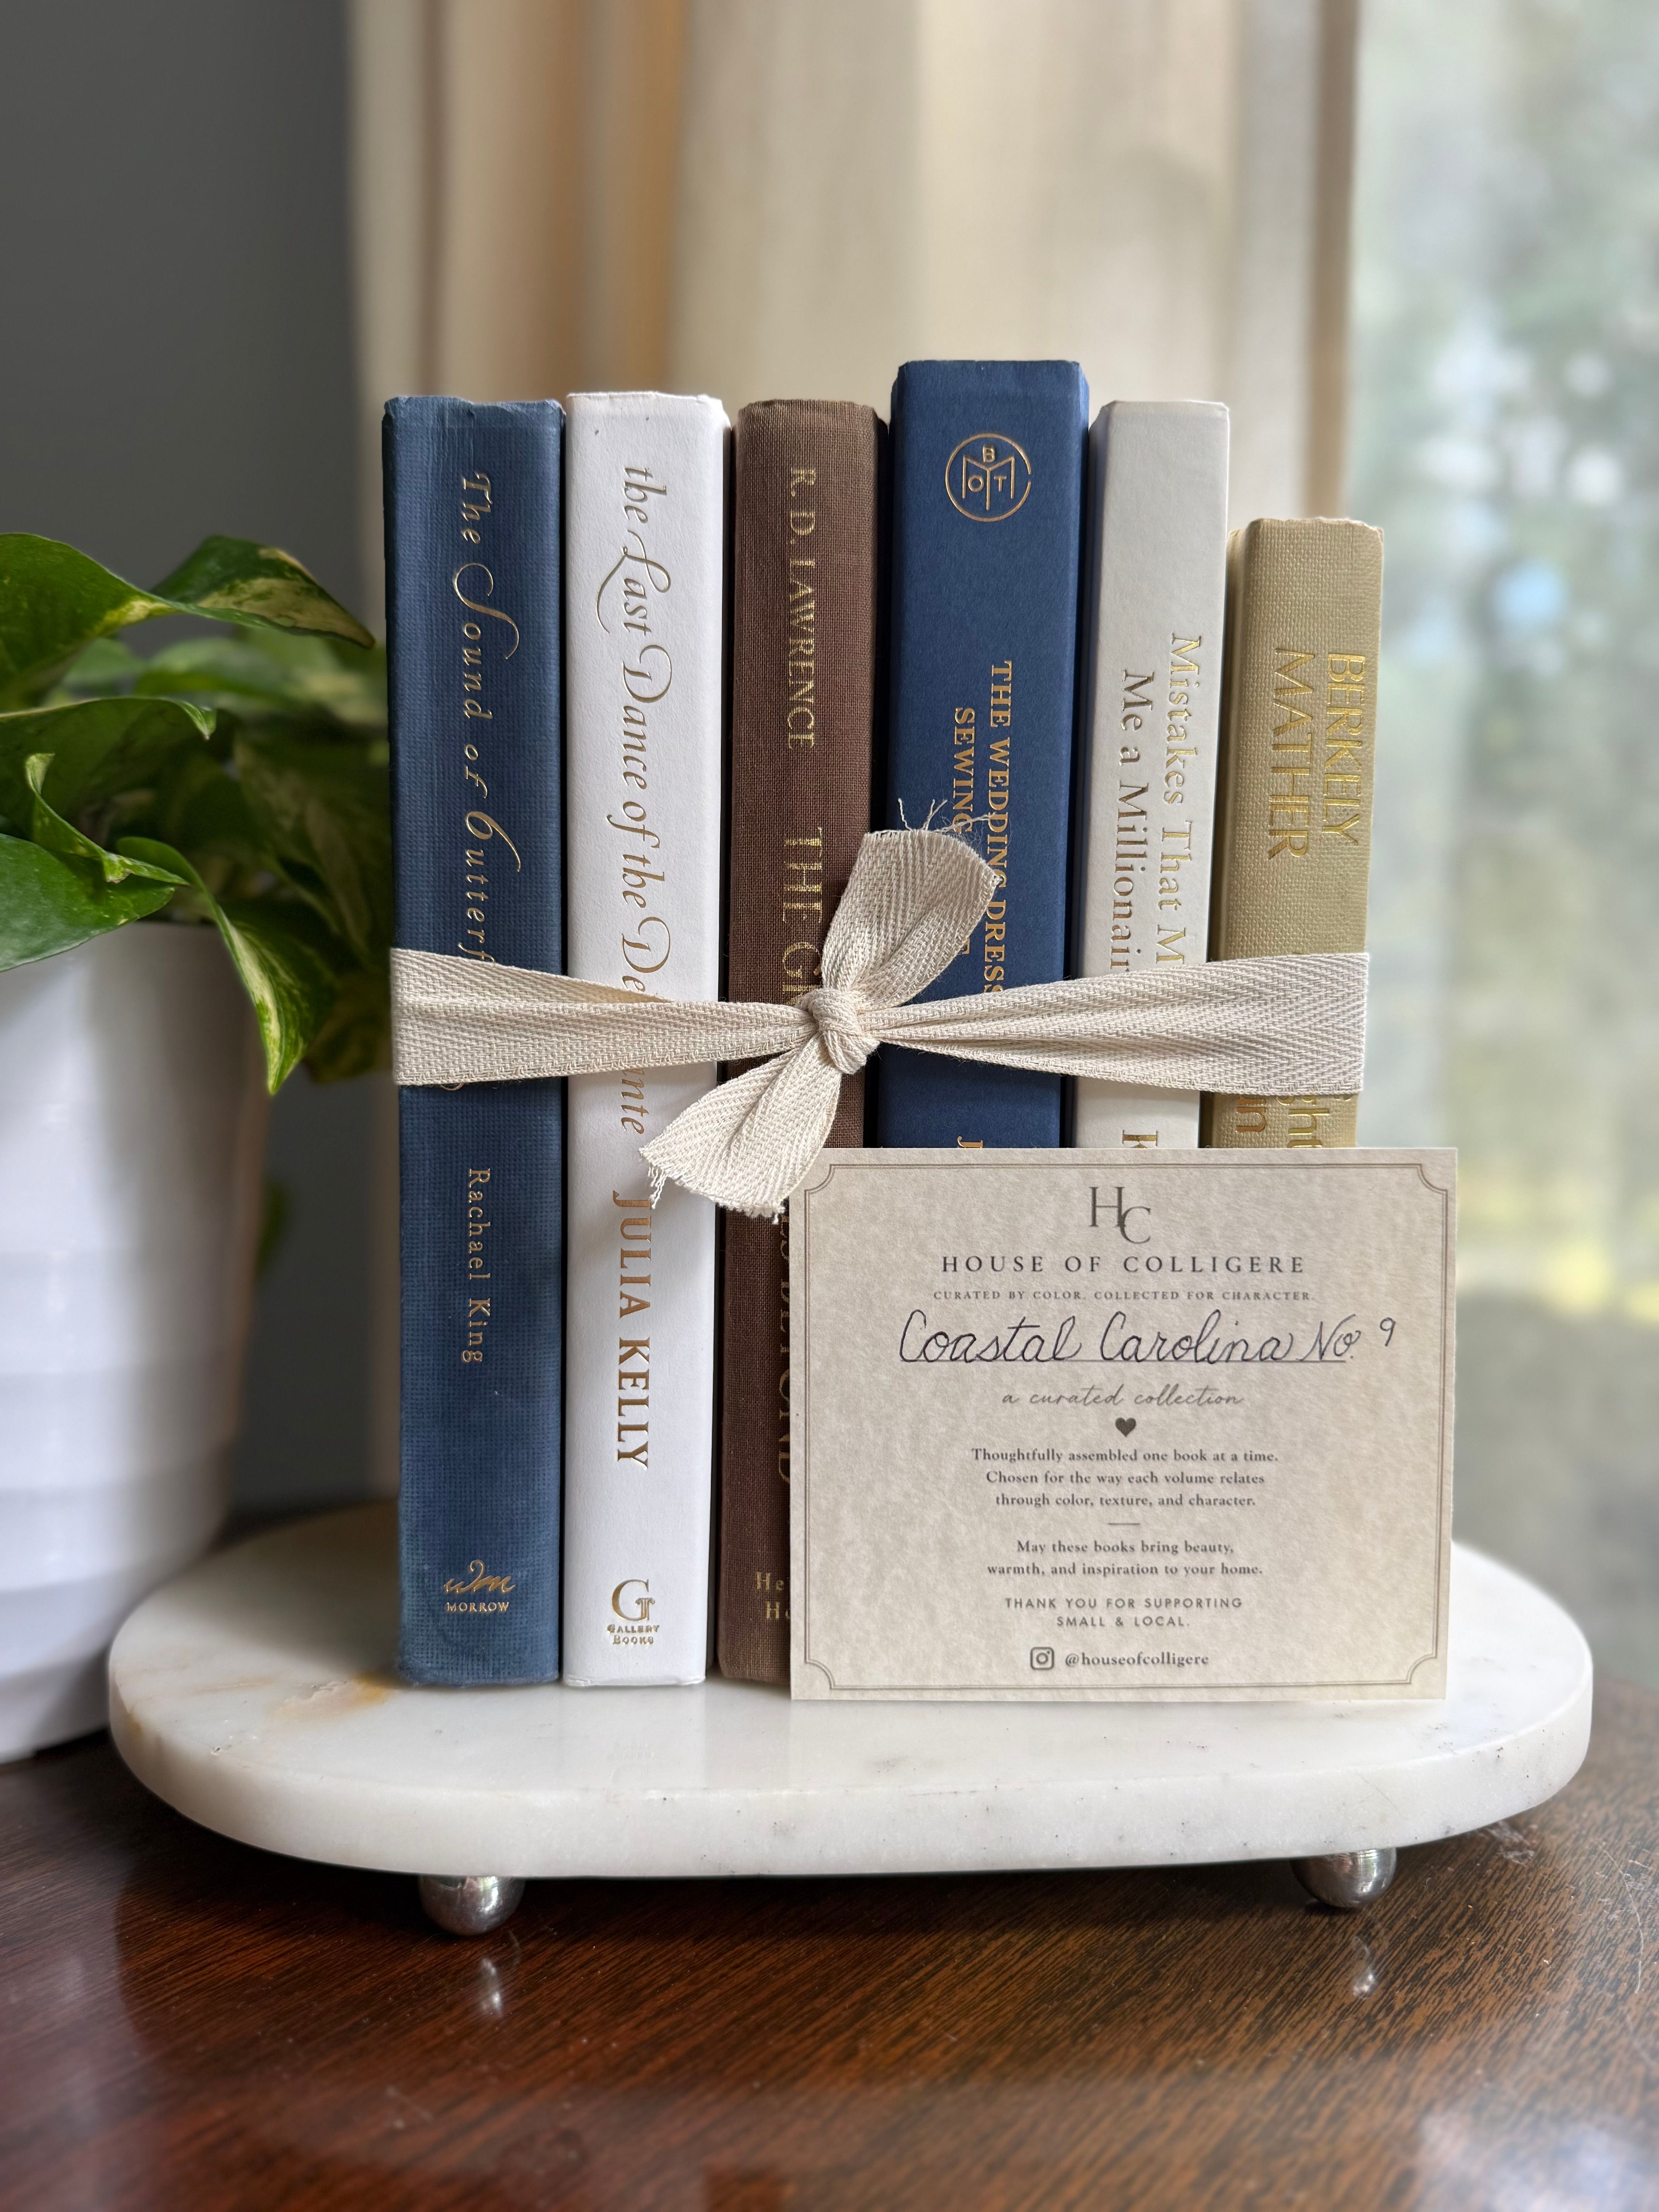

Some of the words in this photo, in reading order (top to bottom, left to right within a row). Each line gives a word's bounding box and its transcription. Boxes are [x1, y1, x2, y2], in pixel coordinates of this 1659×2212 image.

[462, 472, 493, 544] The
[622, 467, 668, 524] the
[790, 510, 816, 545] D.
[596, 530, 672, 636] Last
[452, 563, 520, 720] Sound
[787, 557, 816, 750] LAWRENCE
[621, 644, 672, 790] Dance
[990, 660, 1013, 728] THE
[1121, 669, 1155, 732] Me
[1164, 632, 1202, 806] Mistakes
[464, 744, 488, 799] of
[952, 707, 976, 834] SEWING
[1118, 746, 1141, 766] a
[1267, 647, 1315, 860] MATHER
[1321, 653, 1366, 846] BERKELY
[606, 800, 661, 849] of
[987, 737, 1010, 888] WEDDING
[458, 811, 521, 963] Butterf
[621, 854, 665, 909] the
[783, 826, 823, 924] THE
[1110, 780, 1150, 972] Millionair
[1158, 820, 1192, 911] That
[469, 1168, 491, 1280] Rachael
[613, 1189, 652, 1319] JULIA
[933, 1290, 1001, 1300] CURATED
[1008, 1290, 1025, 1300] BY
[1094, 1291, 1180, 1301] COLLECTED
[1187, 1291, 1214, 1301] FOR
[942, 1255, 1044, 1273] HOUSE
[1064, 1255, 1101, 1273] OF
[1123, 1255, 1304, 1273] COLLIGERE
[461, 1298, 491, 1363] King
[899, 1309, 1082, 1363] Coastal
[1099, 1309, 1294, 1365] Carolina
[1379, 1317, 1397, 1347] 9
[617, 1337, 651, 1470] KELLY
[1001, 1393, 1020, 1405] a
[1029, 1382, 1125, 1407] curated
[1133, 1382, 1245, 1408] collection
[971, 1448, 1063, 1463] Thoughtfully
[1068, 1448, 1138, 1462] assembled
[1142, 1452, 1168, 1462] one
[1173, 1448, 1207, 1462] book
[1212, 1451, 1226, 1462] at
[1230, 1453, 1238, 1462] a
[1243, 1449, 1279, 1462] time.
[986, 1470, 1039, 1484] Chosen
[1043, 1470, 1065, 1484] for
[1069, 1470, 1091, 1484] the
[1096, 1475, 1123, 1486] way
[1127, 1470, 1159, 1484] each
[1163, 1471, 1214, 1485] volume
[1220, 1471, 1265, 1485] relates
[995, 1492, 1051, 1508] through
[1055, 1493, 1094, 1508] color,
[1099, 1496, 1153, 1508] texture,
[1158, 1493, 1183, 1507] and
[1188, 1493, 1256, 1507] character.
[987, 1561, 1046, 1577] warmth,
[1050, 1561, 1077, 1576] and
[1082, 1562, 1159, 1578] inspiration
[1164, 1565, 1179, 1575] to
[1183, 1566, 1216, 1578] your
[1221, 1562, 1263, 1575] home.
[1017, 1539, 1047, 1556] May
[1051, 1539, 1089, 1553] these
[1093, 1539, 1136, 1553] books
[1140, 1539, 1180, 1556] bring
[1184, 1539, 1235, 1556] beauty,
[446, 1601, 510, 1612] MORROW
[1005, 1597, 1057, 1610] THANK
[1065, 1597, 1097, 1609] YOU
[1106, 1597, 1136, 1609] FOR
[1144, 1597, 1243, 1609] SUPPORTING
[1056, 1616, 1106, 1628] SMALL
[1115, 1616, 1125, 1628] &
[1134, 1615, 1191, 1628] LOCAL.
[1064, 1650, 1210, 1670] @houseofcolligere
